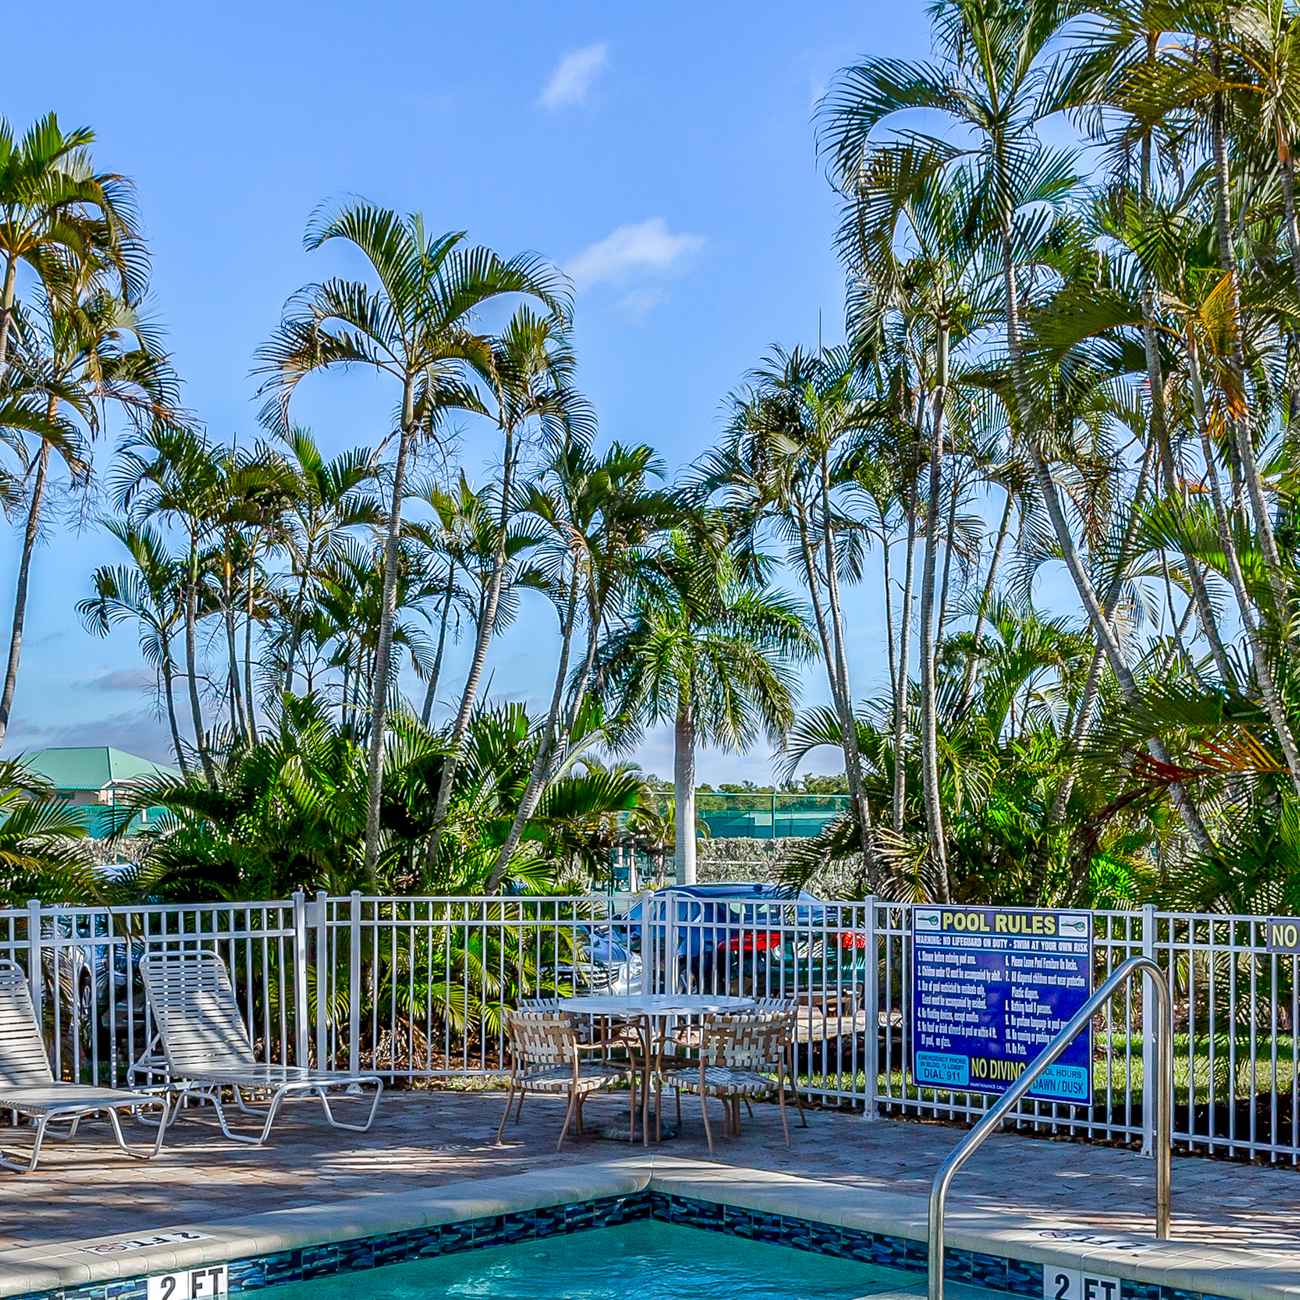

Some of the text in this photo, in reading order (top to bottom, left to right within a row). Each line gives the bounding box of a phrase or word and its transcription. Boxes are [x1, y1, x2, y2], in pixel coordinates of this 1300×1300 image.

[943, 912, 1056, 935] POOL RULES
[1272, 925, 1298, 947] NO
[915, 935, 942, 945] WARNING:
[943, 936, 951, 946] NO
[952, 936, 982, 947] LIFEGUARD
[983, 938, 991, 948] ON
[993, 938, 1008, 948] DUTY
[1014, 940, 1030, 949] SWIM
[1031, 940, 1039, 950] AT
[1041, 941, 1057, 951] YOUR
[1058, 942, 1072, 952] OWN
[1074, 942, 1088, 952] RISK
[1011, 955, 1023, 967] Please
[1024, 956, 1034, 968] Leave
[1034, 956, 1042, 968] Pool
[1043, 957, 1059, 969] Furniture
[922, 965, 935, 977] Children
[936, 966, 945, 977] under
[958, 968, 964, 979] be
[964, 969, 985, 982] accompanied
[986, 969, 991, 983] by
[1033, 972, 1047, 984] children
[1048, 974, 1056, 985] must
[932, 995, 940, 1005] must
[946, 996, 966, 1009] accompanied
[1011, 1014, 1016, 1025] No
[1012, 1029, 1017, 1040] No
[1012, 1043, 1017, 1054] No
[918, 1054, 948, 1063] EMERGENCY
[924, 1068, 960, 1081] DIAL 911
[972, 1058, 987, 1078] NO
[1057, 1069, 1081, 1078] HOURS
[1033, 1079, 1056, 1091] DAWN
[1062, 1081, 1084, 1094] DUSK
[1054, 1274, 1070, 1300] 2
